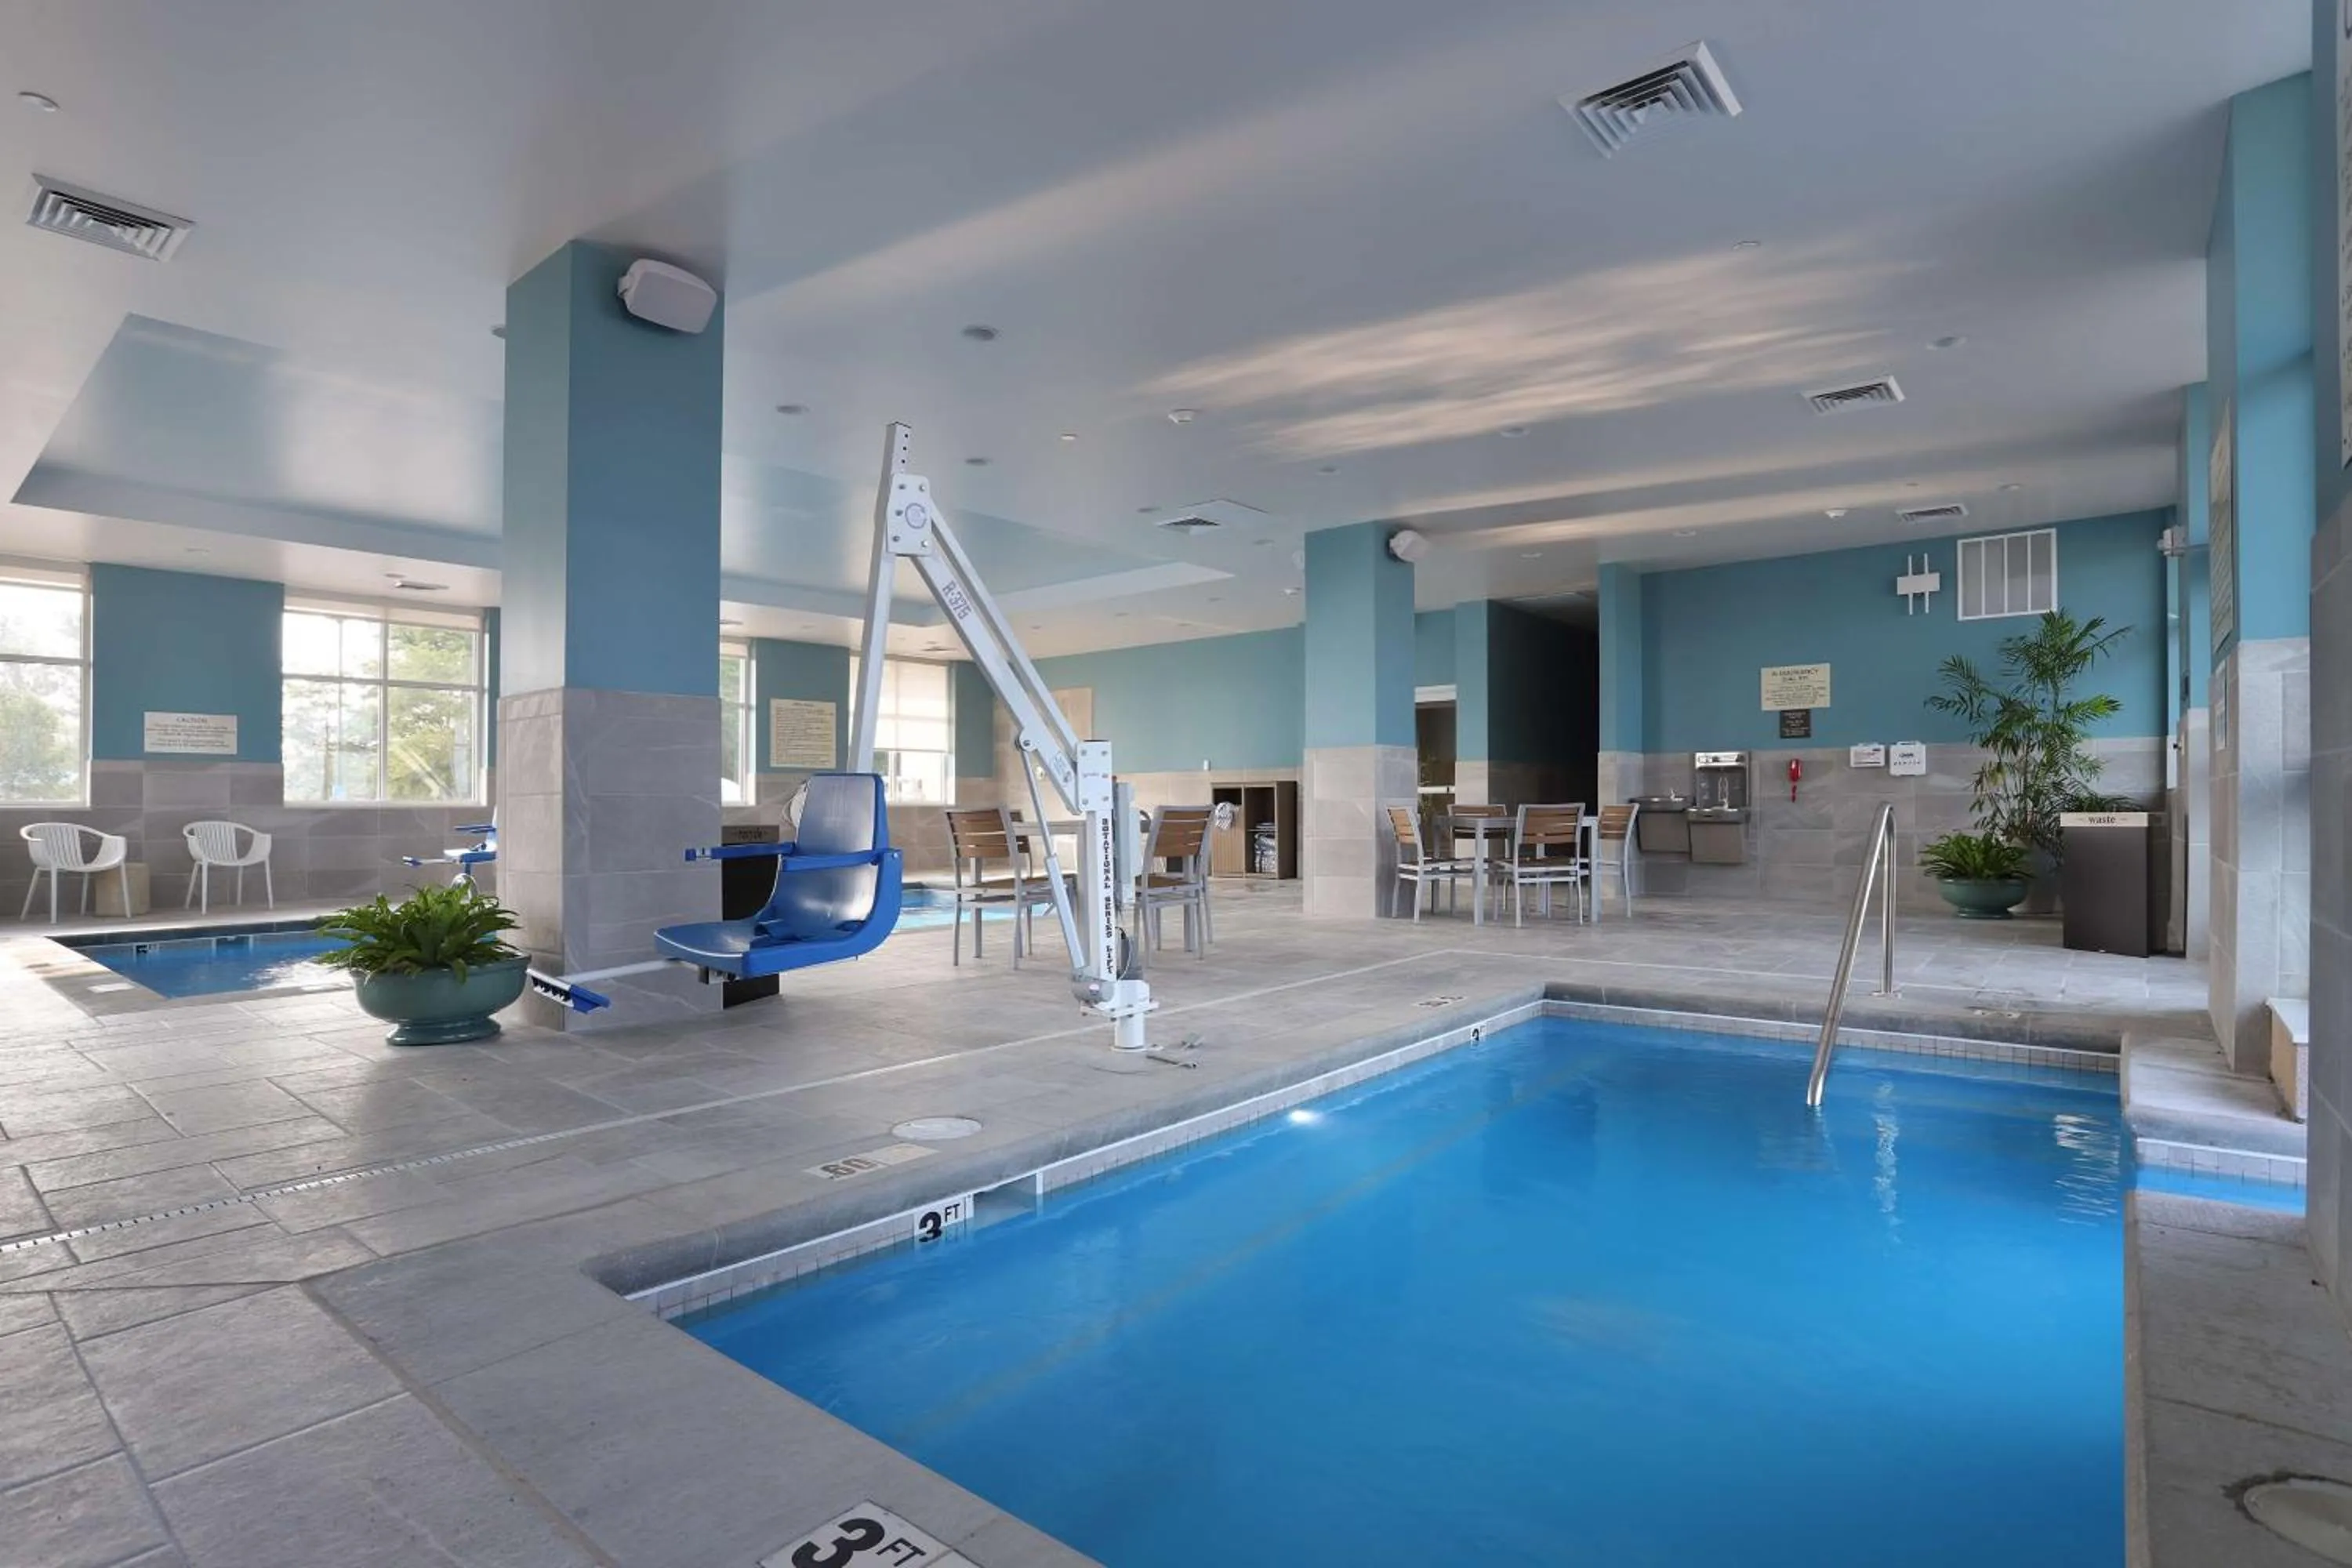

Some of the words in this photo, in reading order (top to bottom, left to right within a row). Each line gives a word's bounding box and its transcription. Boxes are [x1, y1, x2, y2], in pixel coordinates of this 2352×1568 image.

[2088, 815, 2117, 825] waste
[1102, 818, 1112, 889] ROTATIONAL
[1105, 946, 1115, 975] LIFT
[944, 1203, 961, 1223] FT
[791, 1517, 886, 1568] 3
[876, 1537, 927, 1567] FT
